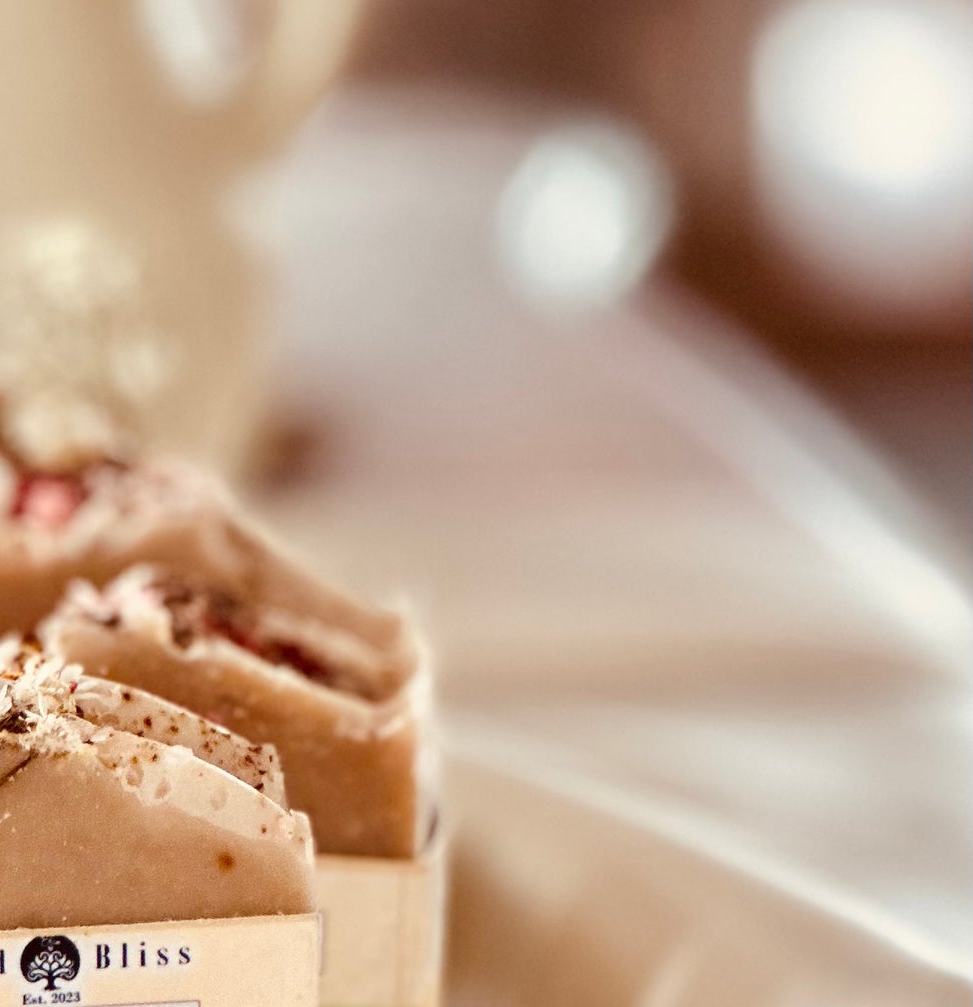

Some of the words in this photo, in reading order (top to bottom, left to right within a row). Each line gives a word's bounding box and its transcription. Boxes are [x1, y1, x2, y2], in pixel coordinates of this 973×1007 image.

[95, 941, 192, 969] Bliss
[22, 993, 46, 1005] Est.
[51, 992, 81, 1004] 2023
